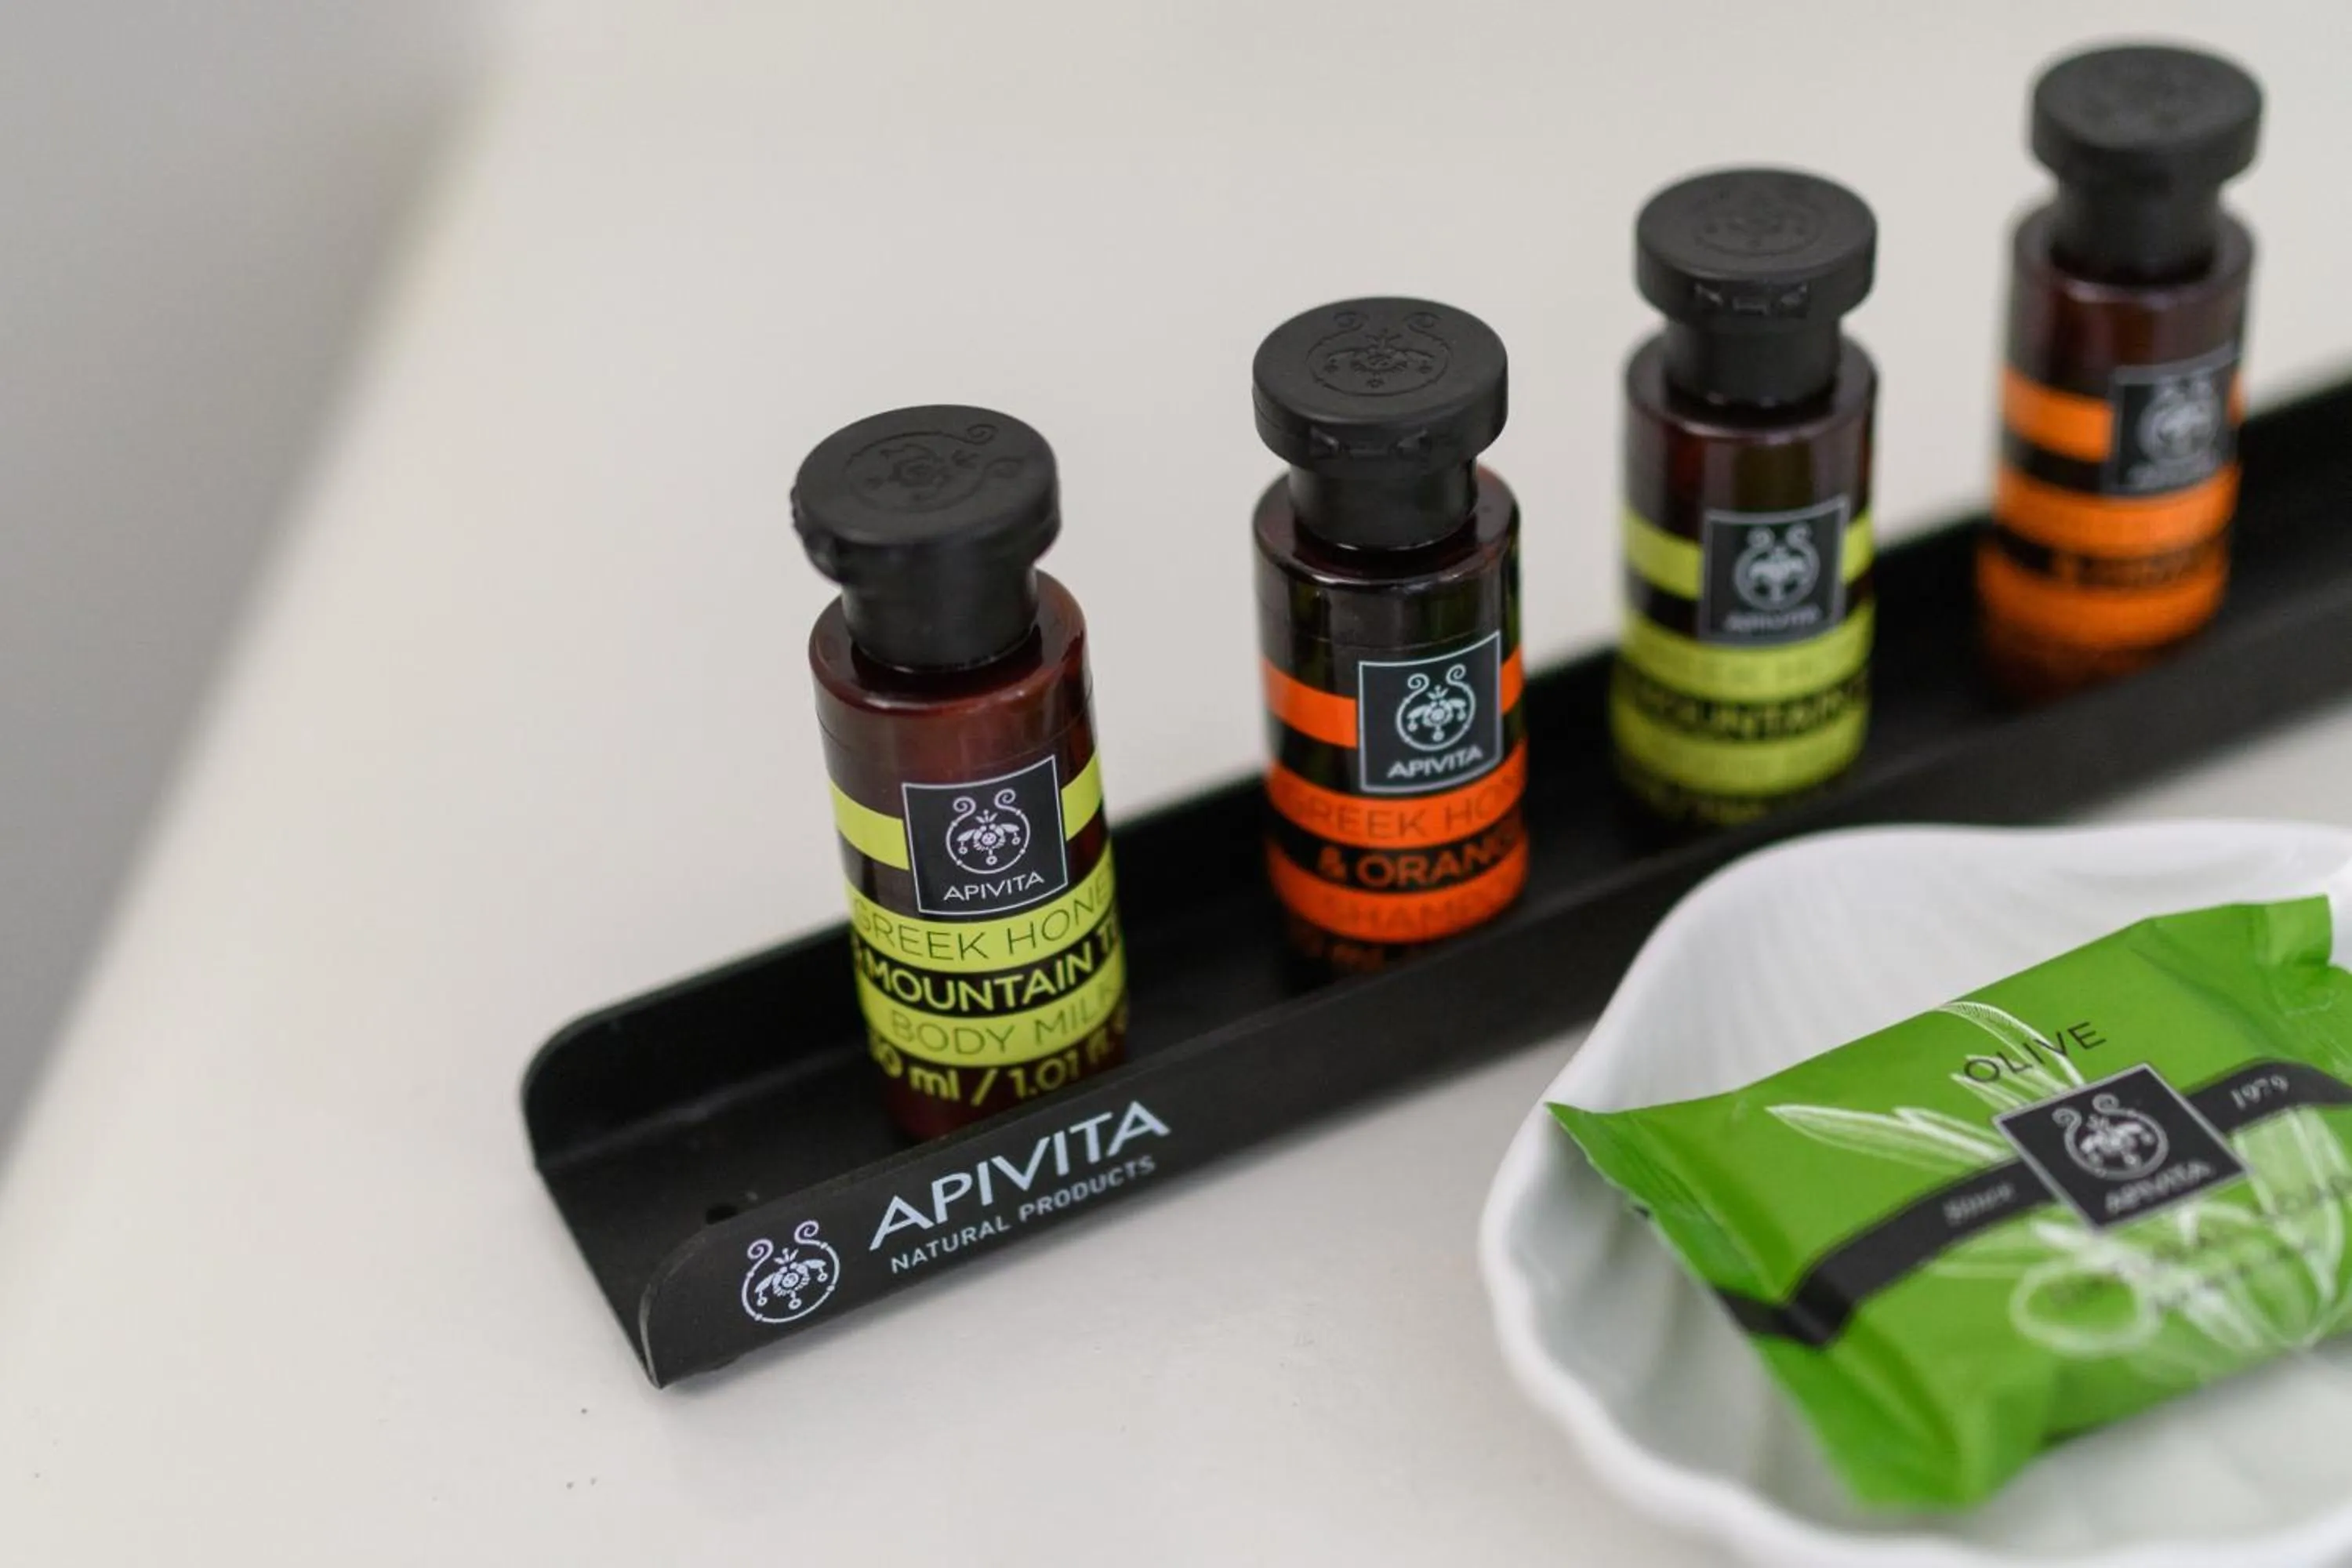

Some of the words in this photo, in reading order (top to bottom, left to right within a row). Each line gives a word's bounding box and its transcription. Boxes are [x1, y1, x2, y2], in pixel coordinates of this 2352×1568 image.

[1387, 745, 1484, 779] APIVITA
[943, 870, 1045, 903] APIVITA
[852, 897, 989, 962] GREEK
[865, 940, 1094, 1011] MOUNTAIN
[891, 1009, 1015, 1056] BODY
[1962, 1021, 2107, 1084] OLIVE
[909, 1066, 961, 1101] ml
[970, 1068, 996, 1107] /
[1007, 1048, 1080, 1099] 1.01
[2230, 1074, 2289, 1110] 1979
[869, 1100, 1171, 1251] APIVITA
[891, 1215, 1011, 1275] NATURAL
[1019, 1153, 1156, 1223] PRODUCTS
